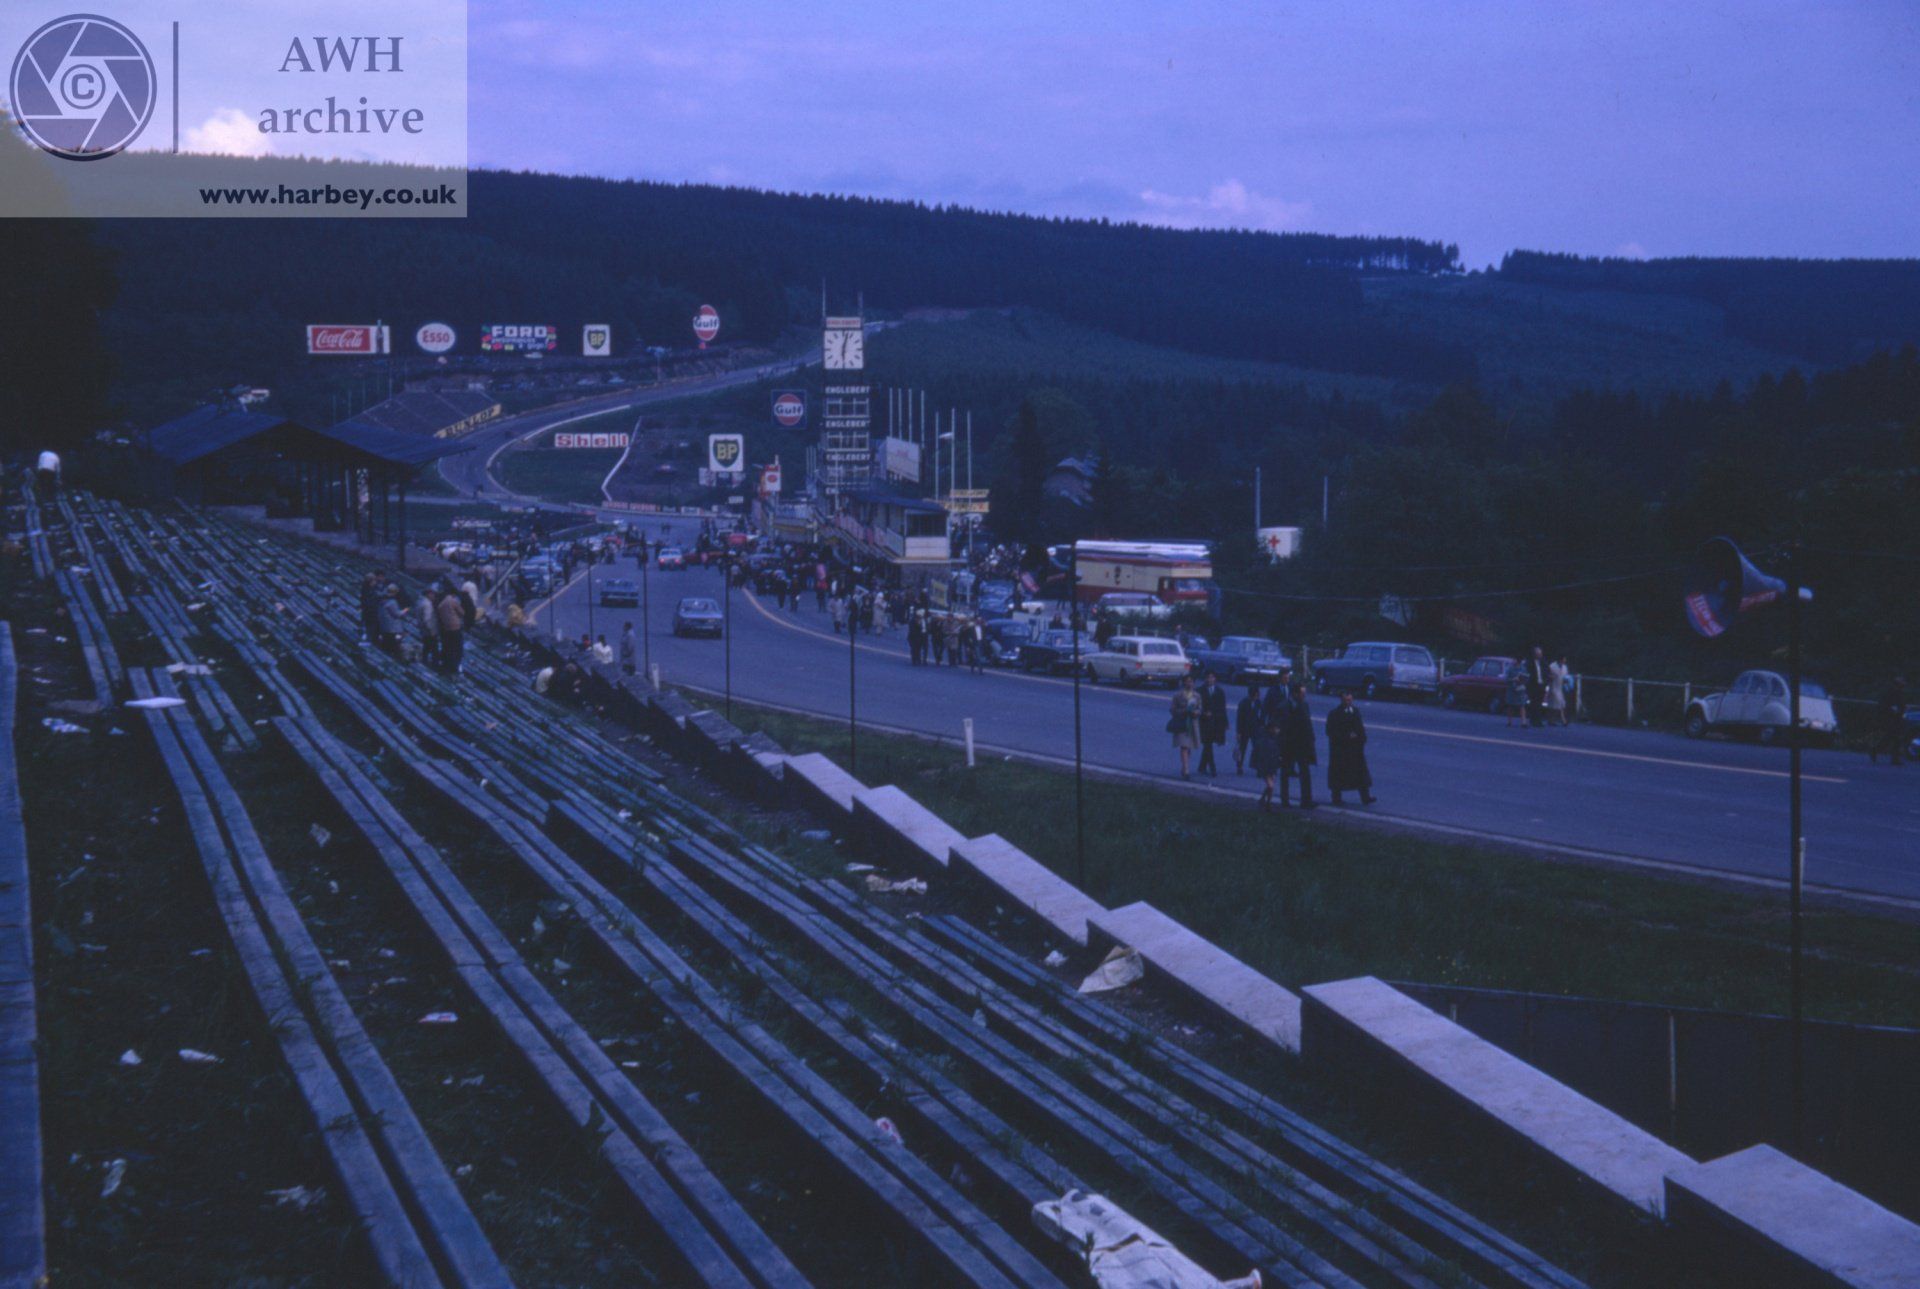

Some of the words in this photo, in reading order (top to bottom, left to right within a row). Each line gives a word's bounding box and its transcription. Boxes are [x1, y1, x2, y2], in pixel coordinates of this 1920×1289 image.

[694, 316, 718, 329] Gulf
[491, 325, 548, 338] FORD
[589, 332, 604, 349] BP
[825, 386, 870, 394] ENGLEBERT
[775, 403, 802, 415] Gulf
[557, 435, 627, 446] Shell
[716, 443, 738, 460] BP
